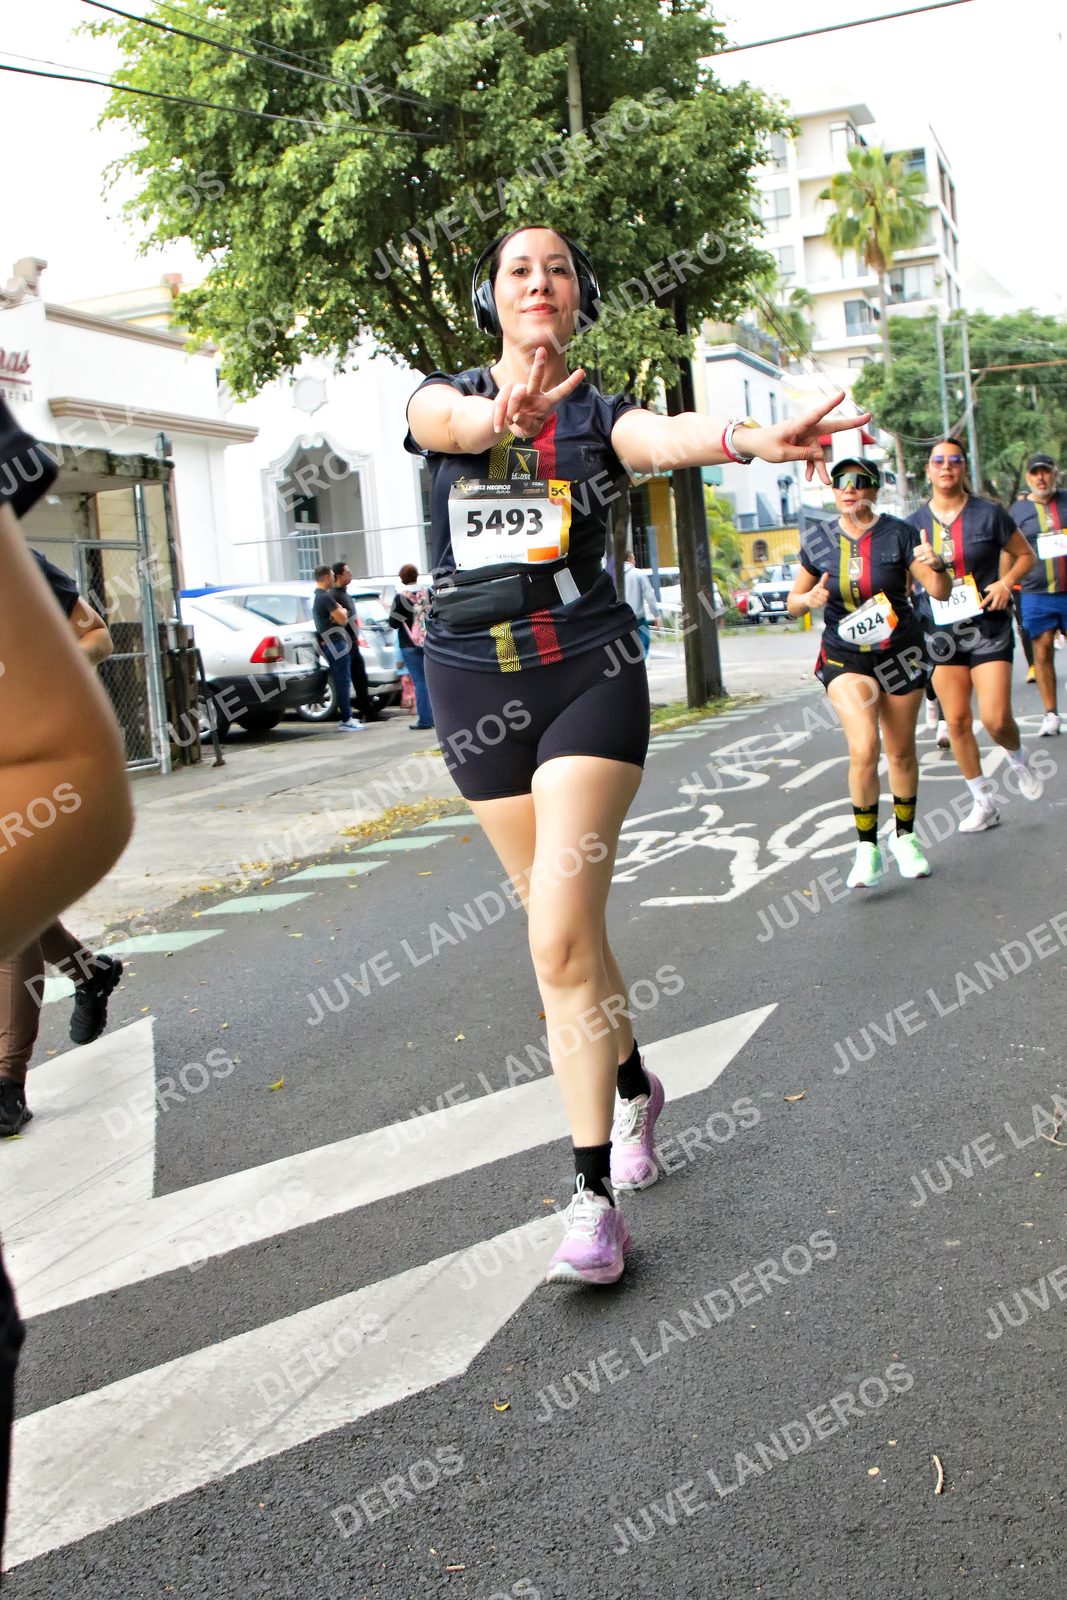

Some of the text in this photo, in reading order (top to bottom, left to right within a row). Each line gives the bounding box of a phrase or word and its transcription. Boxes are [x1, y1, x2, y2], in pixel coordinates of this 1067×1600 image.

[551, 487, 566, 496] 5K
[466, 508, 544, 537] 5493
[847, 612, 885, 640] 7824
